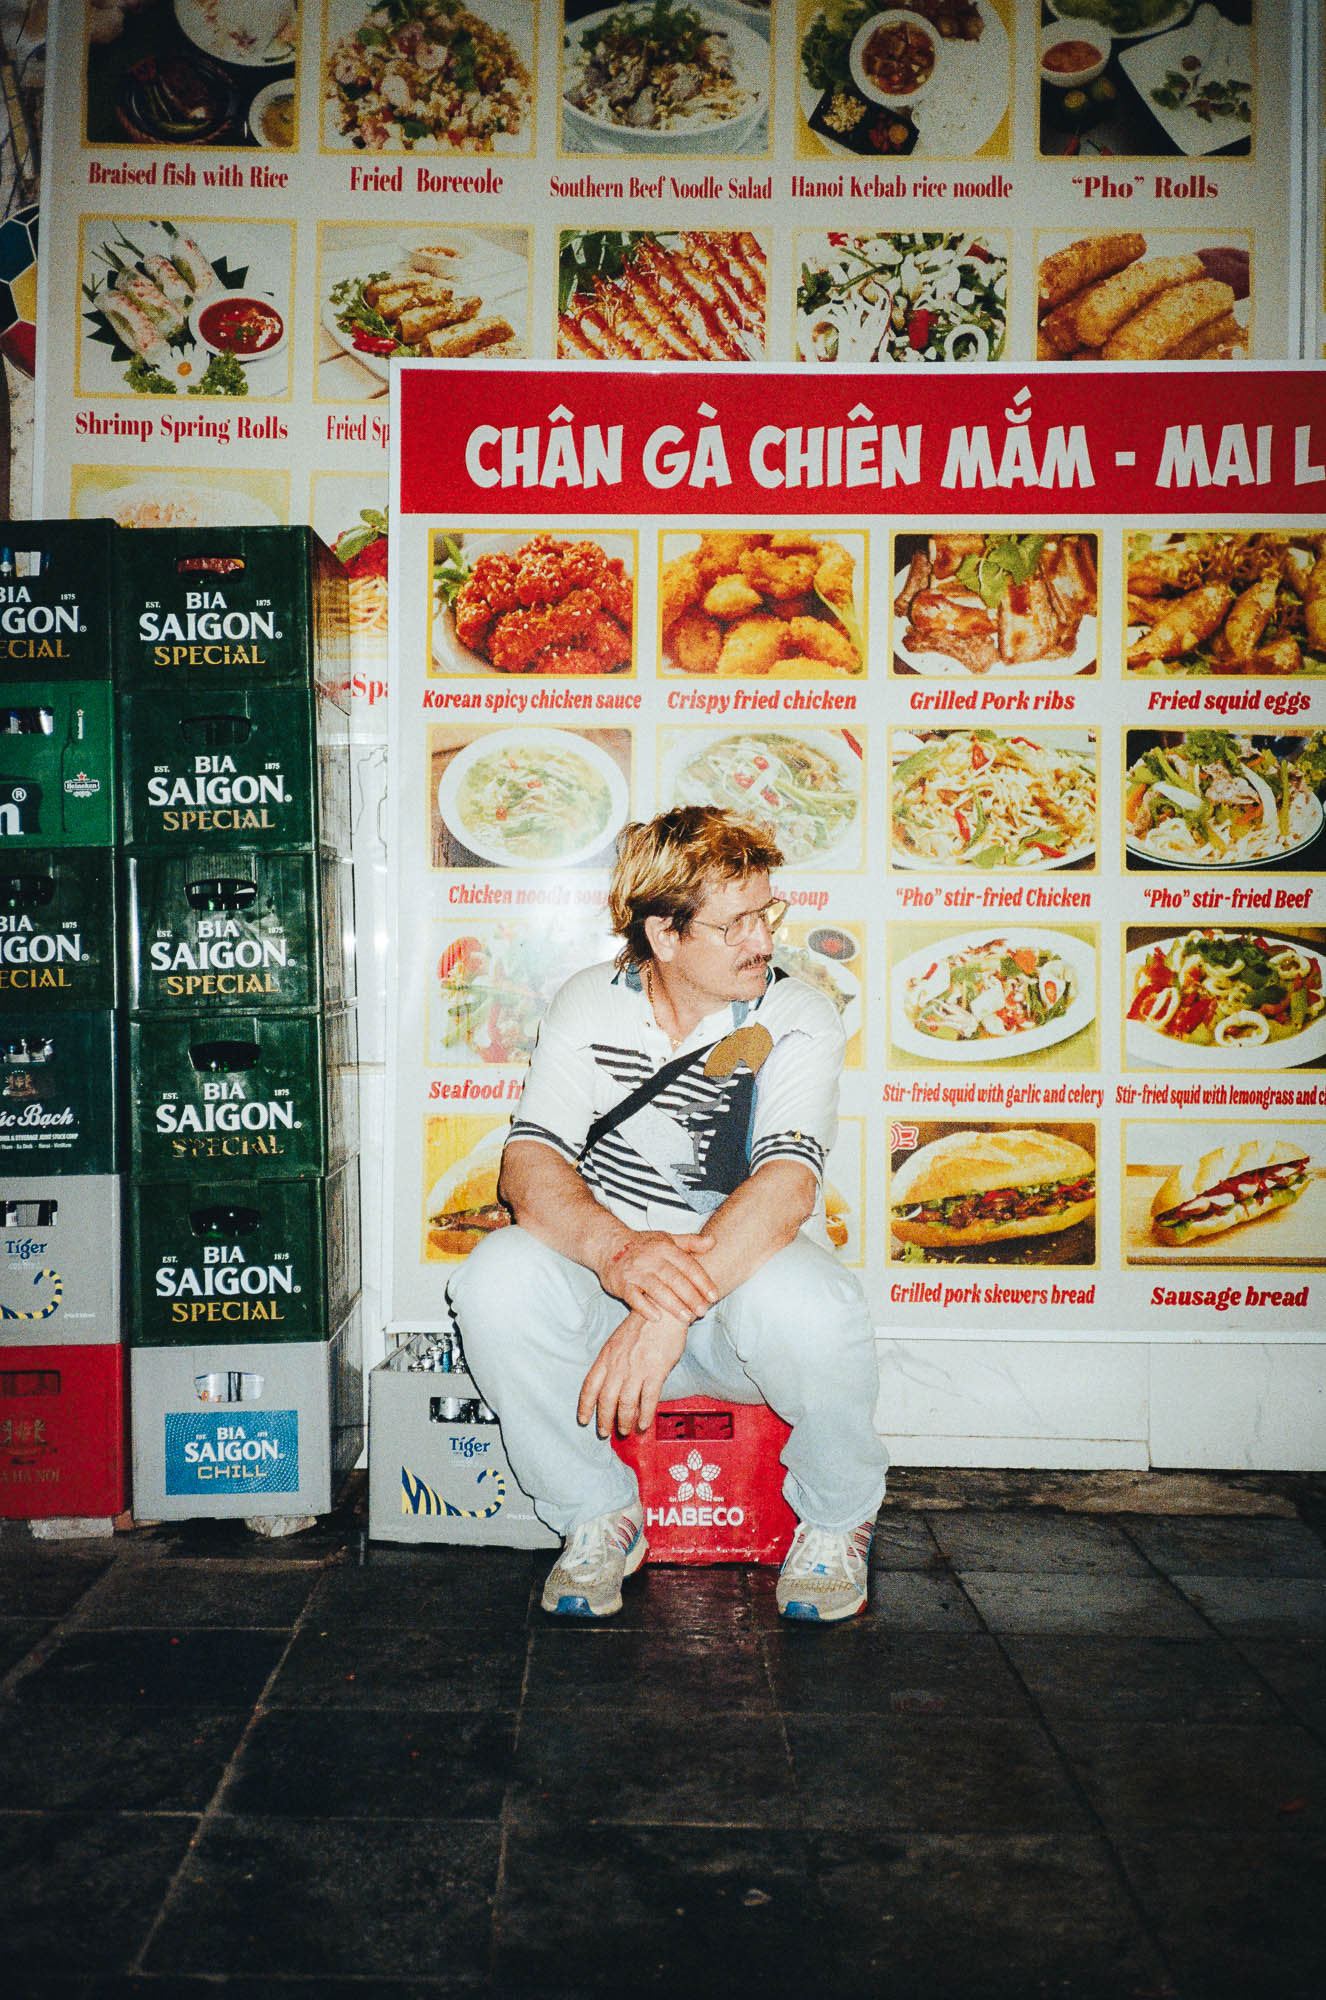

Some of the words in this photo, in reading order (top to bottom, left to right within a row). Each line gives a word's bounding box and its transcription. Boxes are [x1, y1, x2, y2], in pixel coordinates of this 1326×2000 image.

[88, 161, 157, 185] Braised
[163, 161, 196, 187] fish
[203, 164, 243, 187] with
[250, 165, 289, 189] Rice
[350, 165, 403, 192] Fried
[550, 174, 624, 198] Southern
[629, 175, 666, 199] Beef
[669, 176, 723, 199] Noodle
[728, 176, 772, 200] Salad
[791, 175, 844, 198] Hanoi
[850, 174, 907, 198] Kebab
[912, 175, 947, 198] rice
[953, 175, 1013, 198] noodle
[1154, 175, 1219, 199] Rolls
[74, 411, 153, 442] Shrimp
[160, 414, 231, 445] Spring
[237, 415, 288, 439] Rolls
[327, 414, 366, 441] Fried
[464, 403, 624, 490] CHÂN
[642, 401, 733, 489] GÀ
[748, 401, 923, 489] CHIÊN
[939, 385, 1096, 490] MẮM
[1155, 423, 1273, 488] MAI
[186, 591, 228, 609] BIA
[0, 605, 80, 634] GON
[139, 611, 275, 641] SAIGON
[154, 645, 266, 666] SPECIAL
[422, 689, 482, 708] Korean
[485, 688, 528, 713] spicy
[530, 689, 593, 709] chicken
[595, 693, 642, 709] sauce
[667, 689, 730, 714] Crispy
[732, 689, 781, 710] fried
[783, 689, 857, 710] chicken
[910, 689, 979, 710] Grilled
[980, 690, 1030, 711] Pork
[1032, 690, 1076, 711] ribs
[1148, 689, 1202, 710] Fried
[1204, 689, 1262, 715] squid
[1264, 691, 1312, 716] eggs
[195, 755, 237, 774] BIA
[147, 774, 285, 806] SAIGON
[163, 808, 276, 831] SPECIAL
[448, 883, 513, 904] Chicken
[789, 890, 830, 911] soup
[944, 886, 1024, 908] stir-fried
[1026, 886, 1092, 908] Chicken
[1192, 887, 1273, 909] stir-fried
[1274, 888, 1314, 909] Beef
[197, 920, 240, 938] BIA
[0, 934, 81, 964] GON
[150, 939, 288, 971] SAIGON
[0, 968, 72, 989] ECIAL
[167, 973, 281, 996] SPECIAL
[203, 1082, 246, 1100] BIA
[428, 1079, 505, 1100] Seafood
[882, 1081, 941, 1103] Stir-fried
[942, 1083, 976, 1107] squid
[977, 1082, 1004, 1103] with
[1005, 1083, 1041, 1109] garlic
[1043, 1084, 1066, 1104] and
[1067, 1083, 1105, 1109] celery
[1115, 1083, 1169, 1104] Stir-fried
[1170, 1084, 1201, 1109] squid
[1202, 1084, 1227, 1105] with
[1228, 1084, 1294, 1110] lemongrass
[1296, 1085, 1317, 1106] and
[155, 1101, 294, 1134] SAIGON
[5, 1238, 48, 1260] Tiger
[203, 1246, 246, 1264] BIA
[155, 1265, 294, 1297] SAIGON
[890, 1282, 943, 1303] Grilled
[943, 1282, 981, 1308] pork
[983, 1283, 1049, 1305] skewers
[1050, 1283, 1096, 1305] bread
[1150, 1286, 1242, 1312] Sausage
[1244, 1286, 1310, 1307] bread
[172, 1300, 285, 1323] SPECIAL
[217, 1426, 246, 1441] BIA
[184, 1439, 279, 1463] SAIGON
[448, 1436, 491, 1458] Tiger
[197, 1464, 268, 1480] CHILL
[646, 1506, 745, 1527] HABECO
